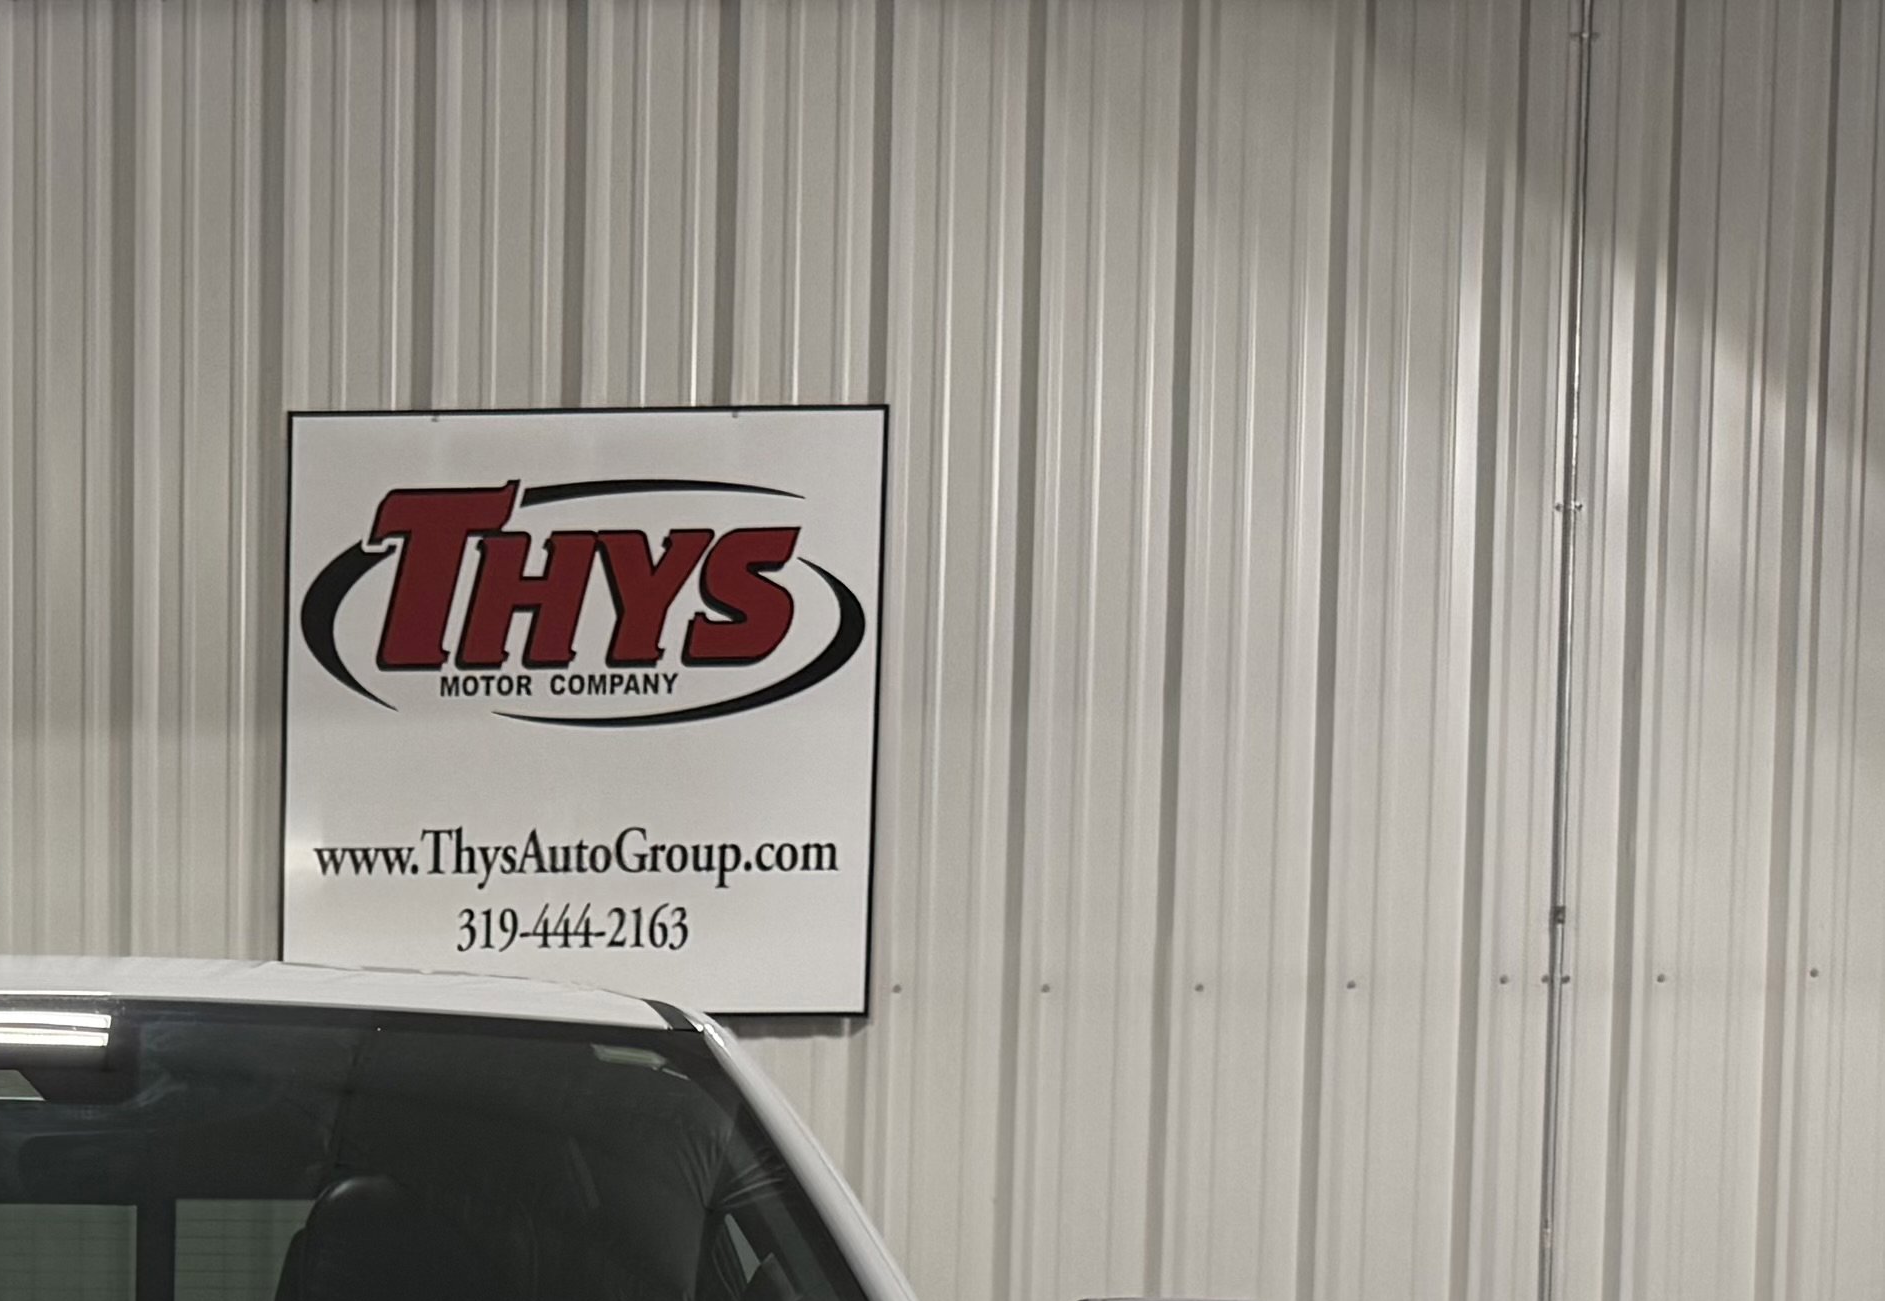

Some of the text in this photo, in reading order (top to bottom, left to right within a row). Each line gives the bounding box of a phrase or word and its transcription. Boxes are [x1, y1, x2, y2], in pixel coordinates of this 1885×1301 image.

[369, 479, 802, 670] THYS
[439, 672, 679, 697] MOTOR COMPANY
[313, 826, 840, 889] www.ThysAutoGroup.com
[456, 903, 689, 952] 319-444-2163
